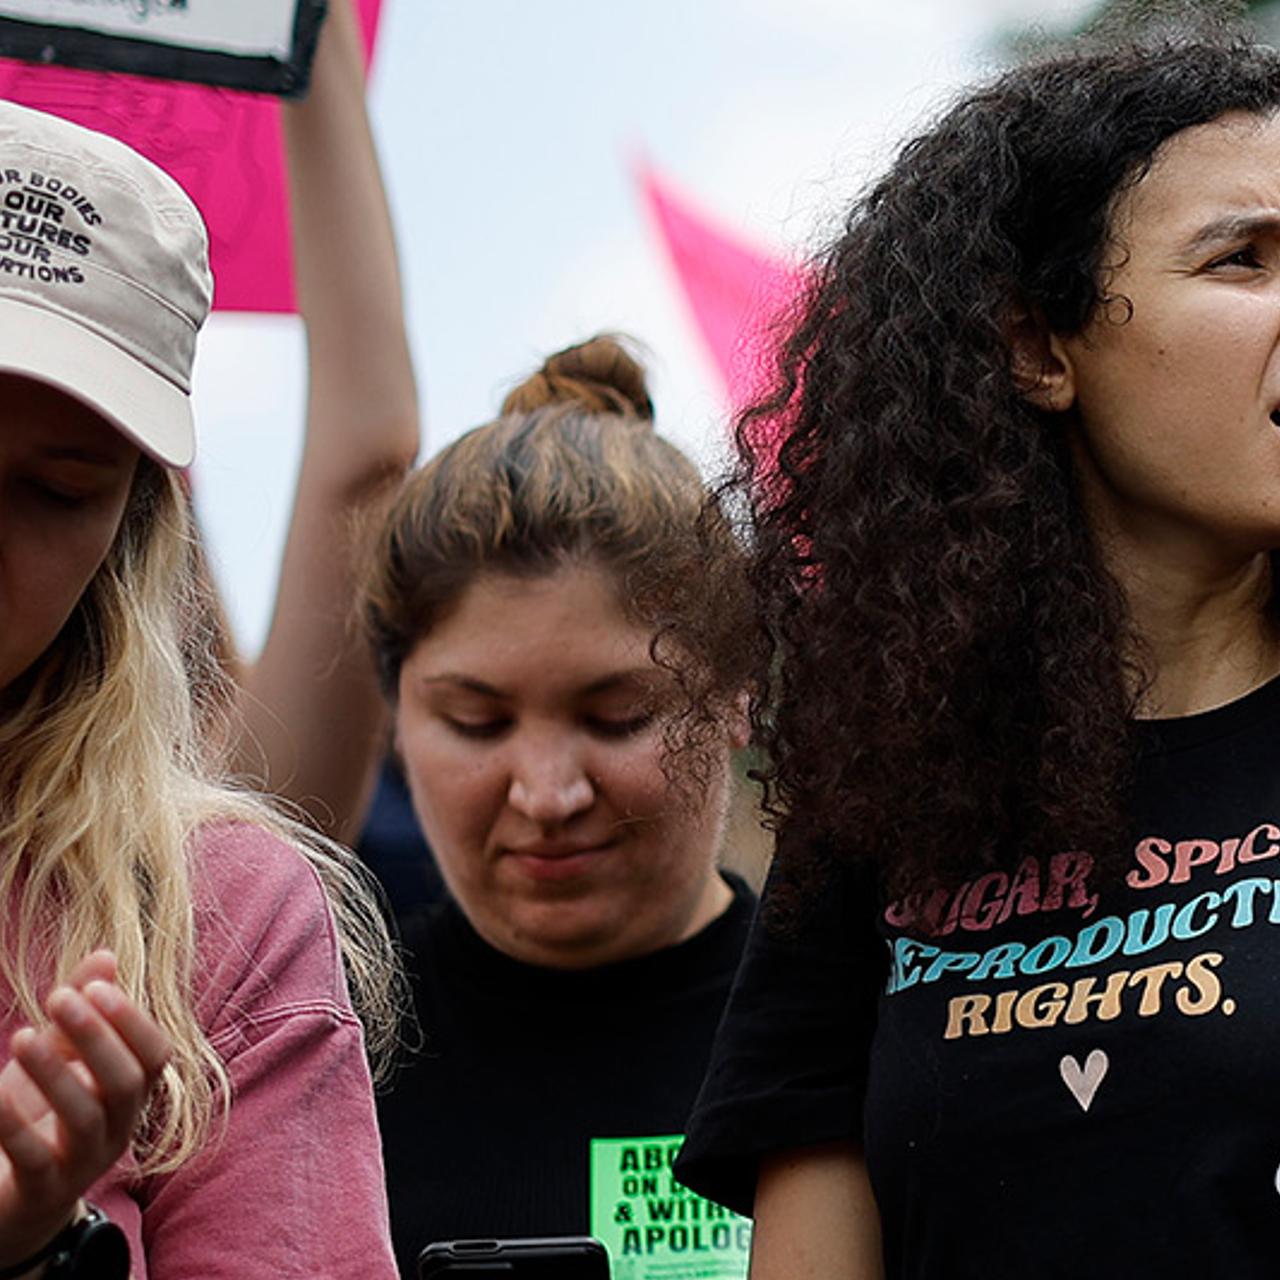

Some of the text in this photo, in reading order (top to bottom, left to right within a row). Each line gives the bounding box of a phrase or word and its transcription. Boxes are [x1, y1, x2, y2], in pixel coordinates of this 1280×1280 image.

[5, 190, 65, 224] OUR
[30, 171, 103, 226] BODIES
[942, 952, 1237, 1039] RIGHTS.
[622, 1175, 658, 1198] ON
